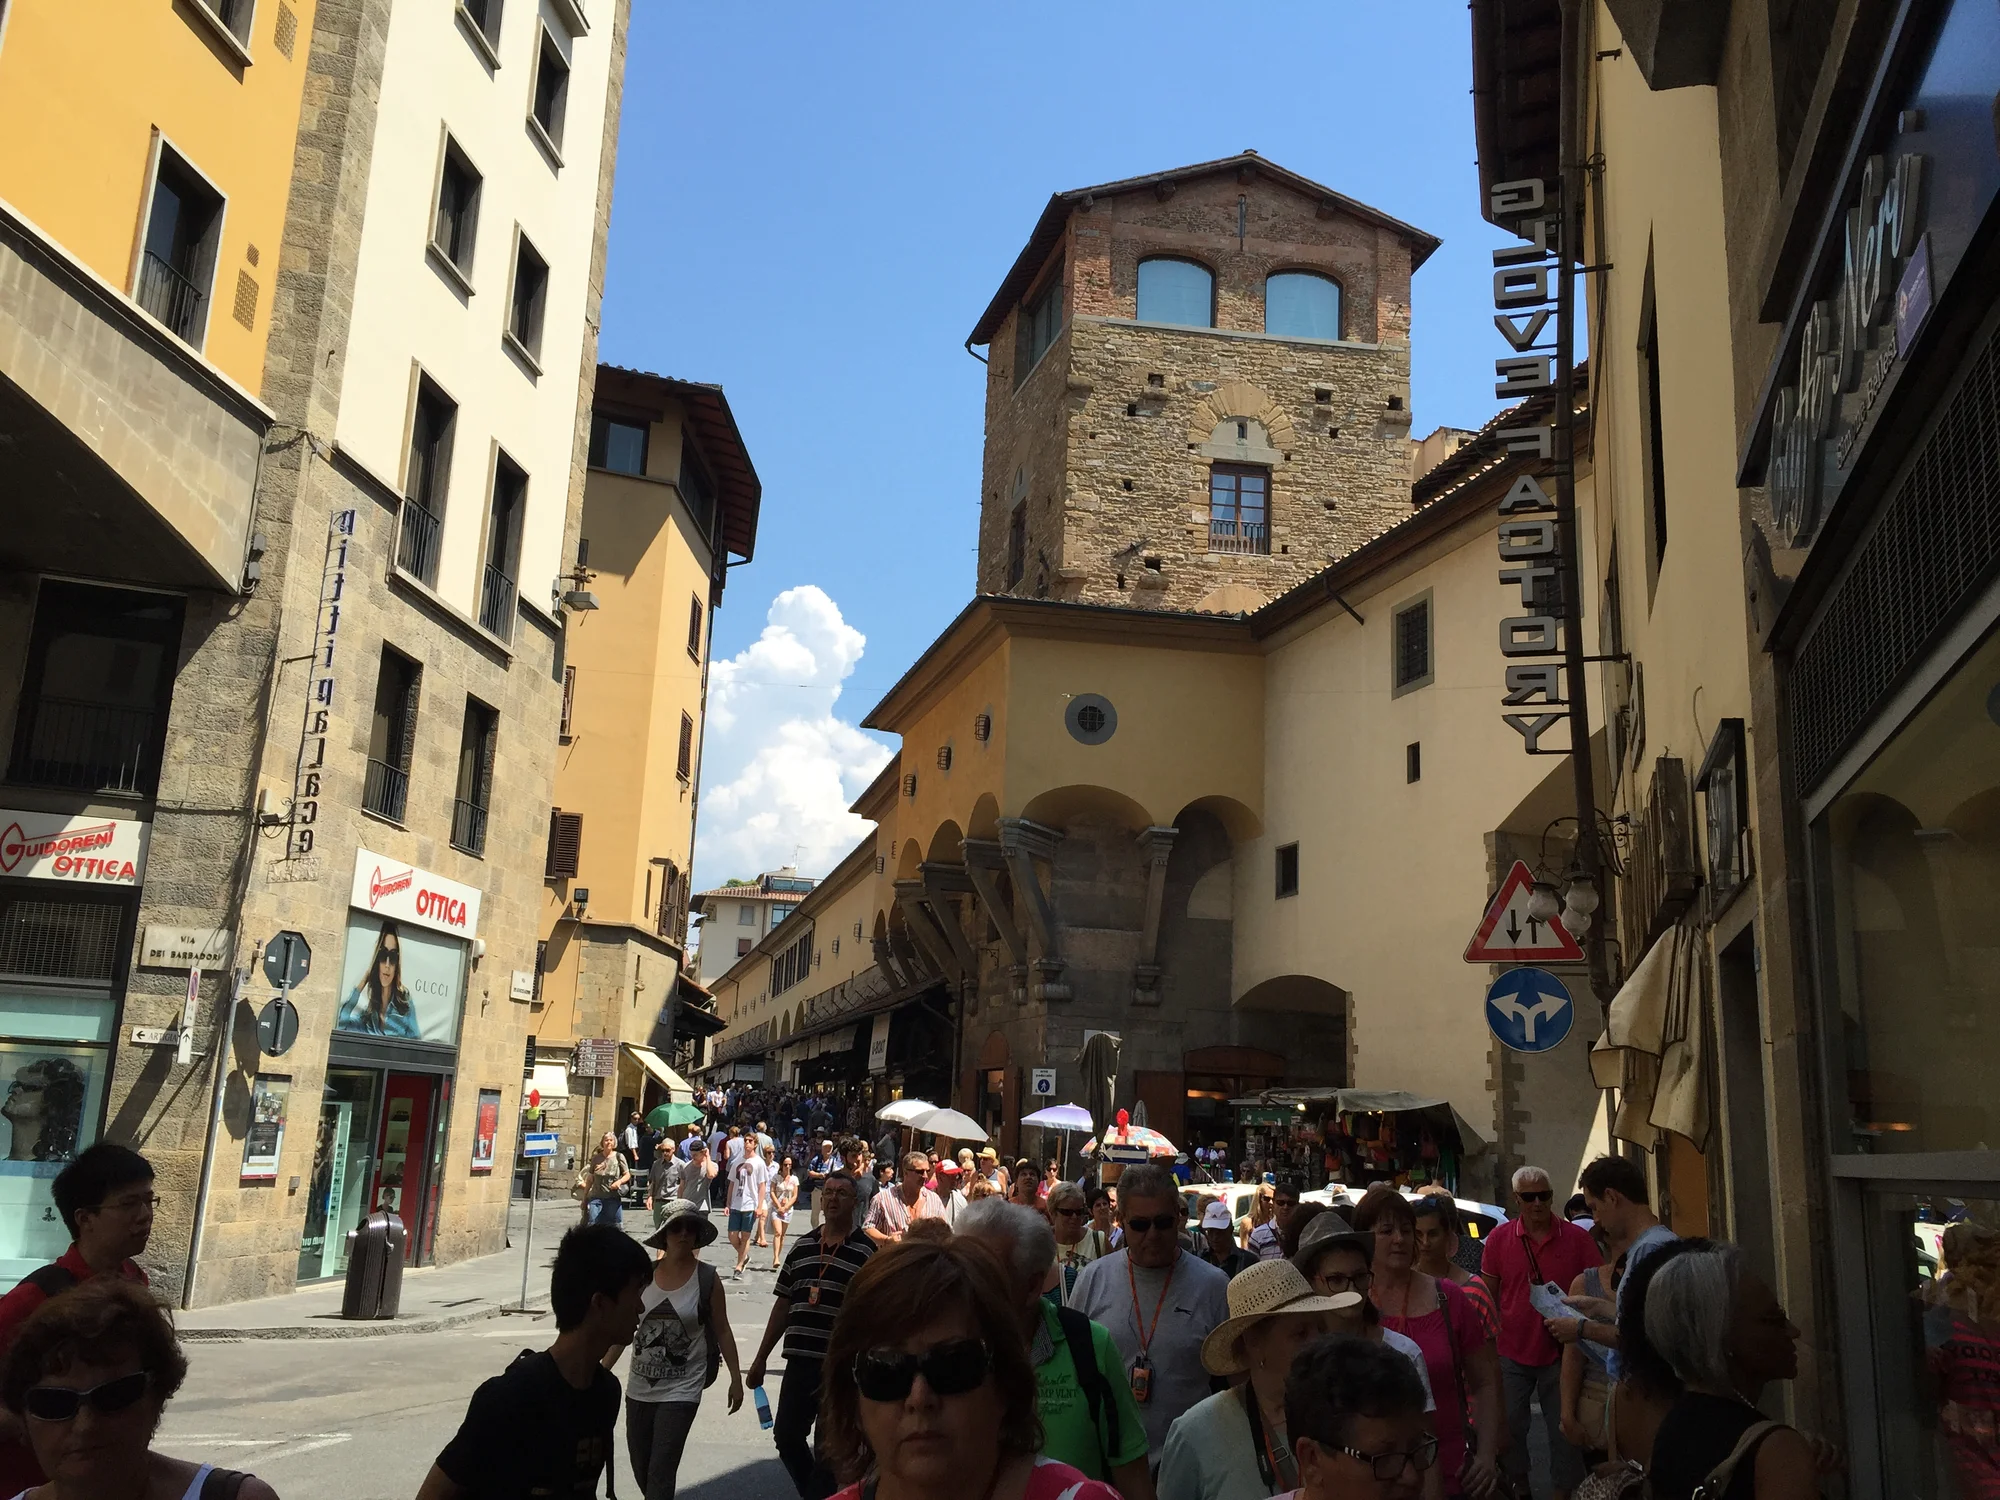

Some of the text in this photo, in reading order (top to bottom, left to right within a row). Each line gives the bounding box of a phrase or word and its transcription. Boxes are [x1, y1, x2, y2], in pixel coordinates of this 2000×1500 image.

[1832, 110, 1922, 394] Neri
[0, 822, 116, 873] GUIDORENI
[53, 856, 136, 880] OTTICA
[416, 889, 466, 927] OTTICA
[180, 936, 195, 945] VIA
[150, 949, 221, 961] DEI BARBADORI
[415, 979, 449, 997] GUCCI
